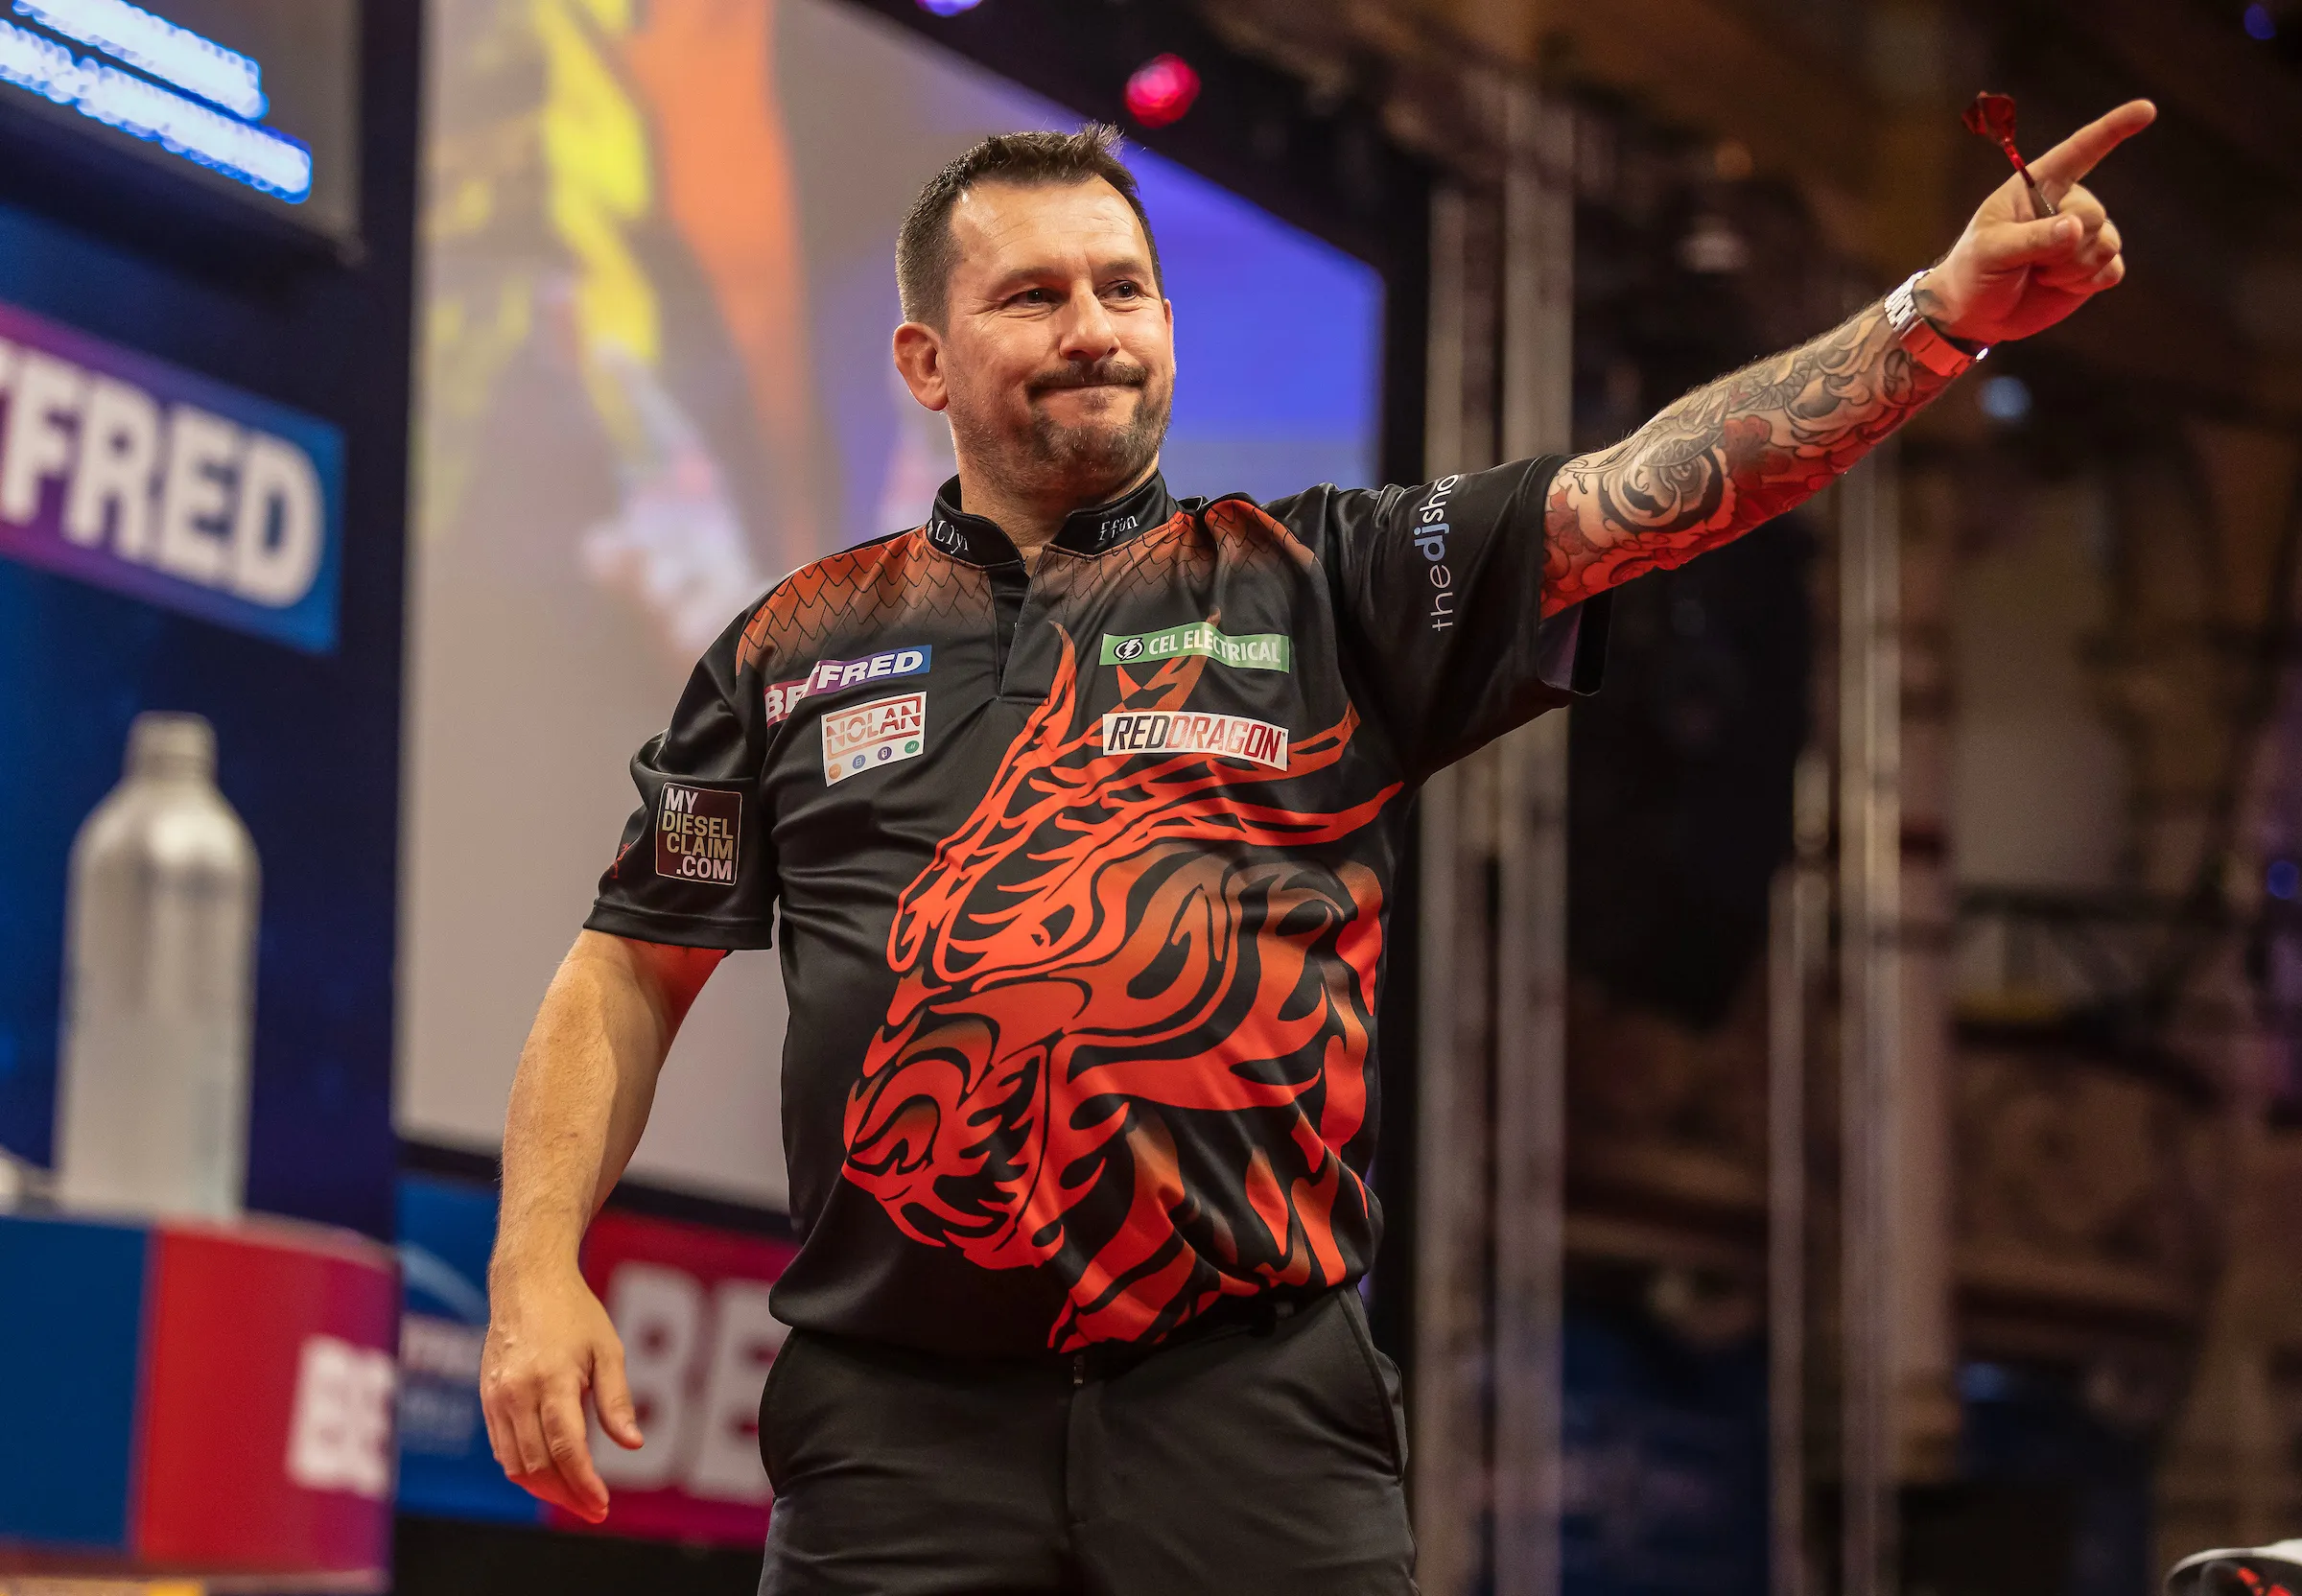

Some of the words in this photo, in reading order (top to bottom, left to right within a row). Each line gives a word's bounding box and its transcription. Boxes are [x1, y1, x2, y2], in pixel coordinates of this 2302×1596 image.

[1148, 634, 1179, 655] CEL
[1183, 628, 1281, 663] ELECTRICAL
[826, 704, 921, 748] NOLAN
[1107, 715, 1282, 763] REDDRAGON
[664, 787, 699, 814] MY
[662, 810, 734, 839] DIESEL
[666, 832, 734, 860] CLAIM
[676, 855, 733, 880] .COM
